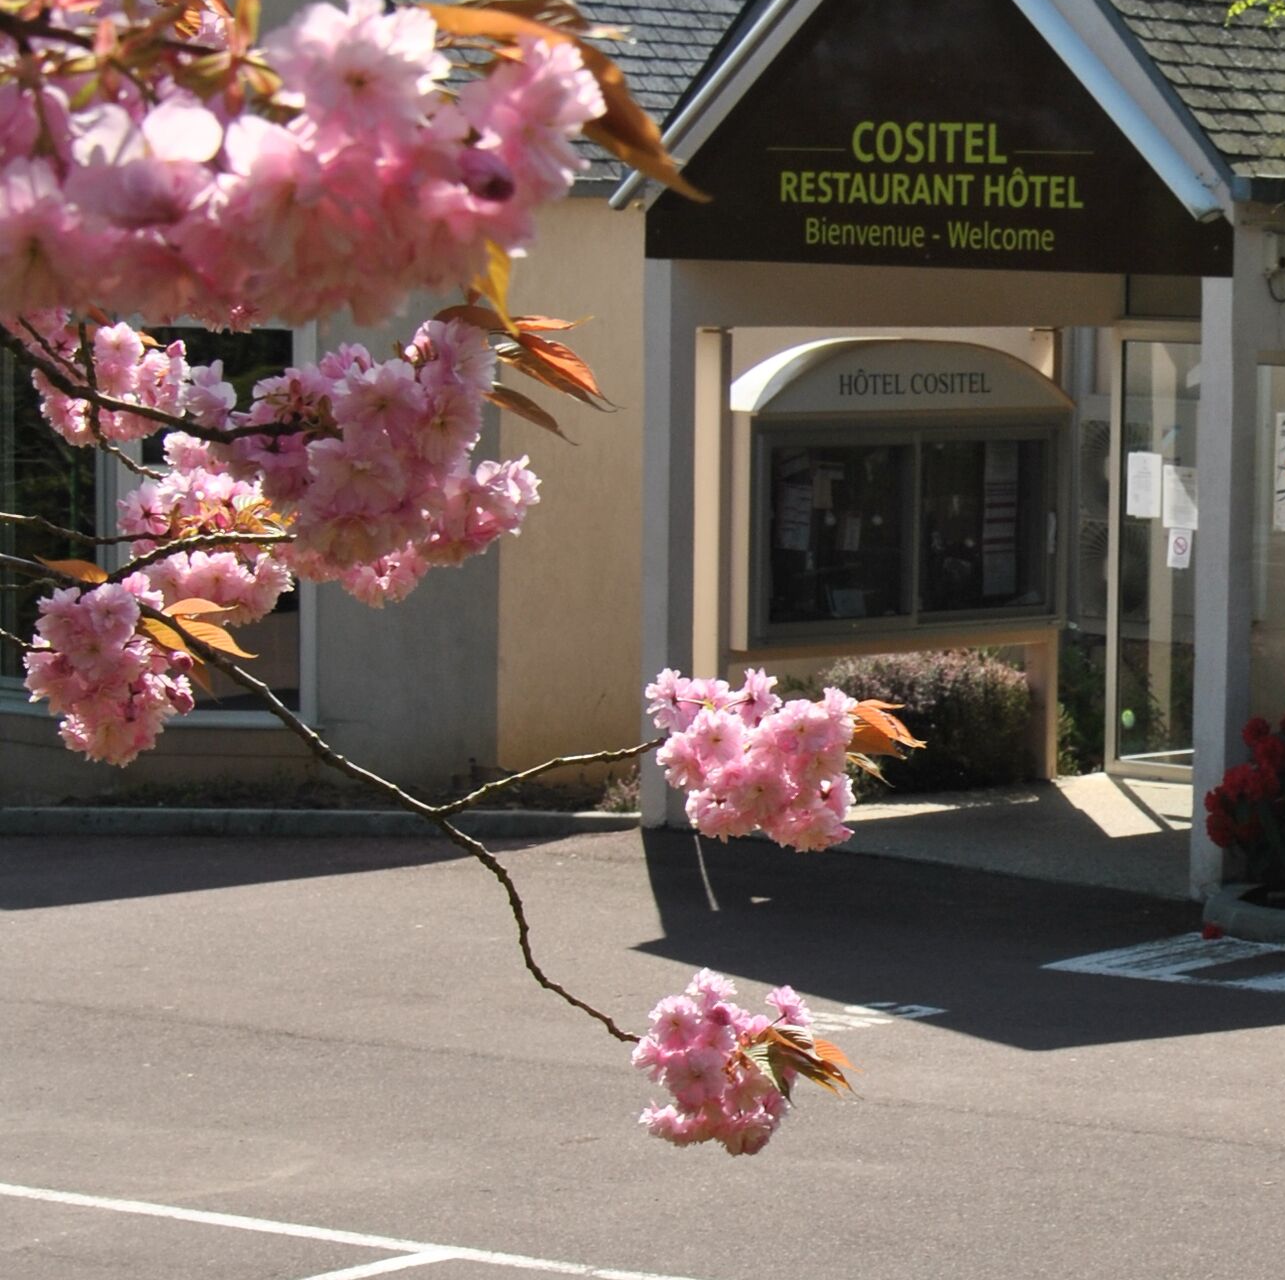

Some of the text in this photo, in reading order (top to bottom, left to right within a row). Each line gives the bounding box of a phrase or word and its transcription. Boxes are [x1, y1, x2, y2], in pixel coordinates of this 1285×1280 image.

[851, 120, 1008, 164] COSITEL
[779, 167, 1085, 209] RESTAURANT HÔTEL
[804, 217, 926, 248] Bienvenue
[947, 220, 1056, 252] Welcome
[838, 368, 992, 396] HÔTEL COSITEL
